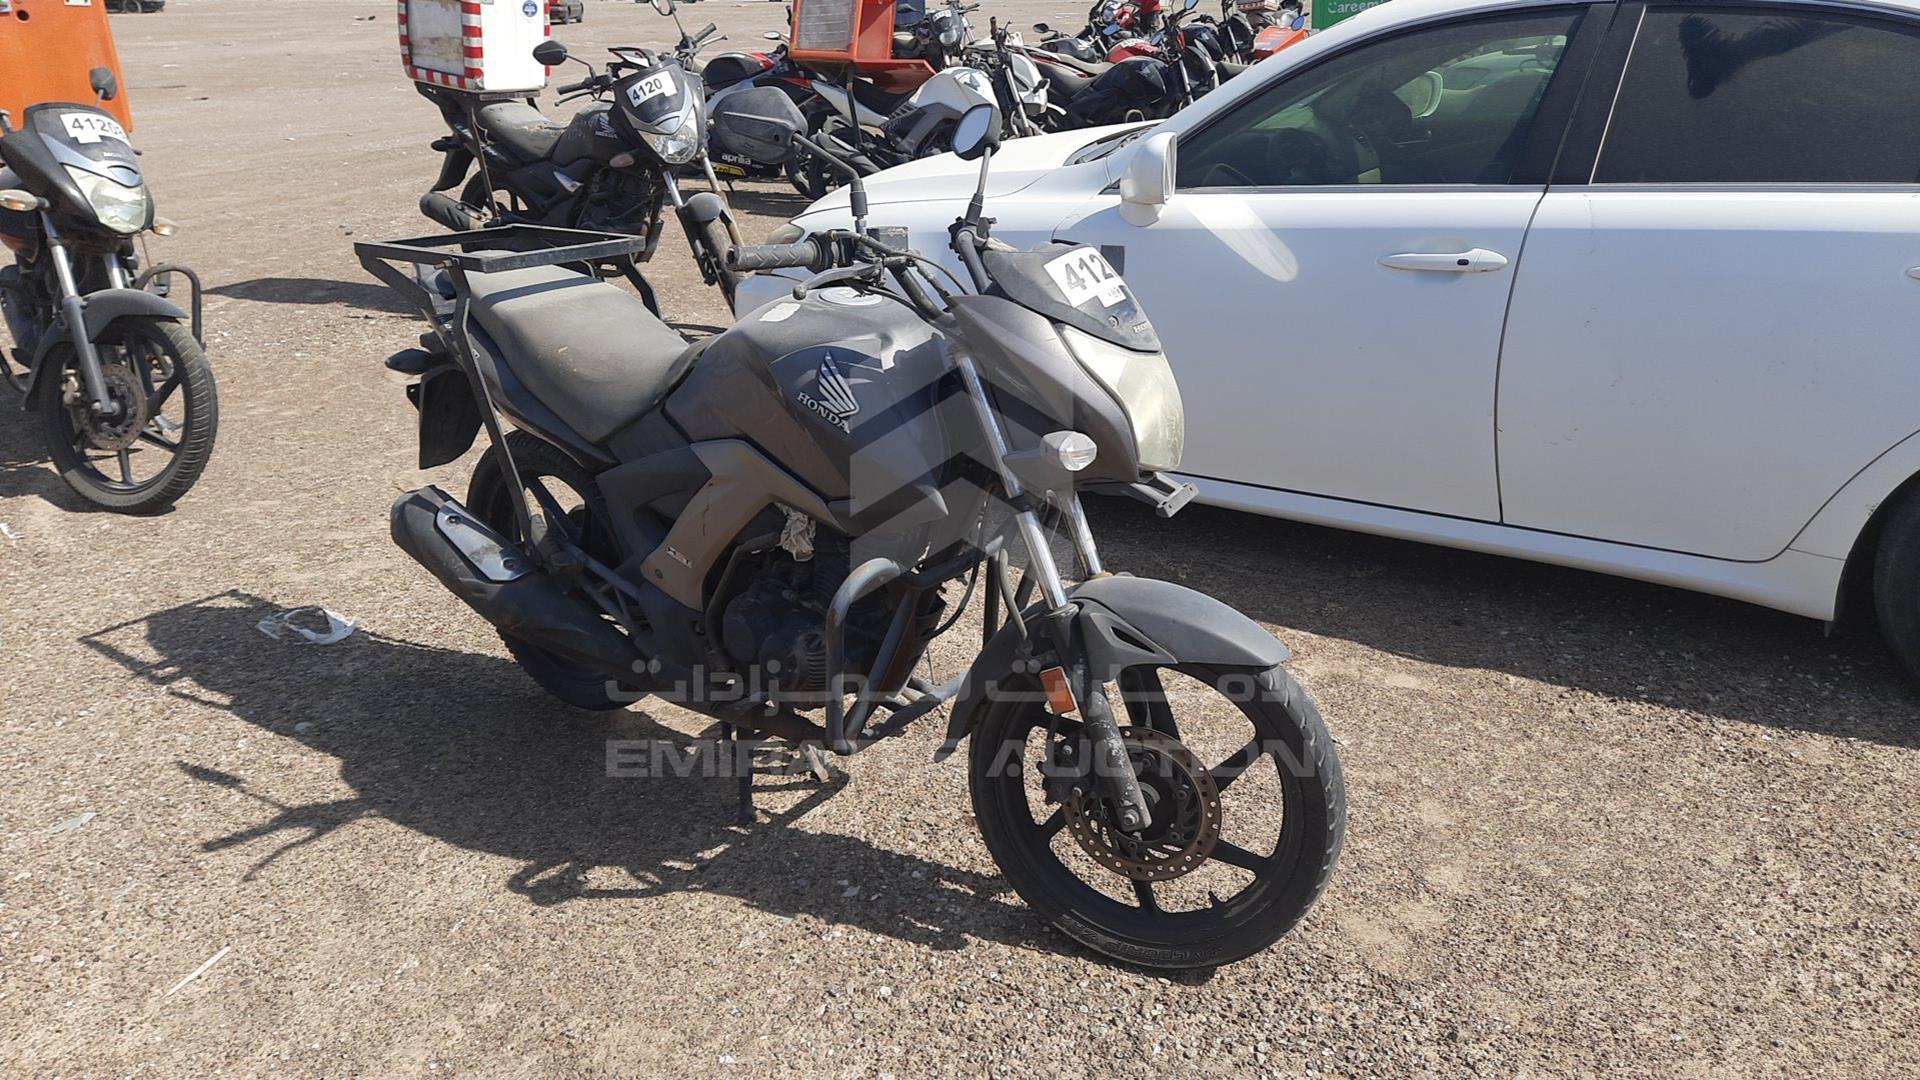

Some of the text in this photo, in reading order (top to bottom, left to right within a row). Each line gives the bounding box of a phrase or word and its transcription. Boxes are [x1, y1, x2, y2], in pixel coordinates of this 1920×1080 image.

[632, 78, 663, 101] 4120
[721, 153, 752, 165] aprilia
[1065, 253, 1117, 290] 412
[797, 392, 850, 434] HONDA
